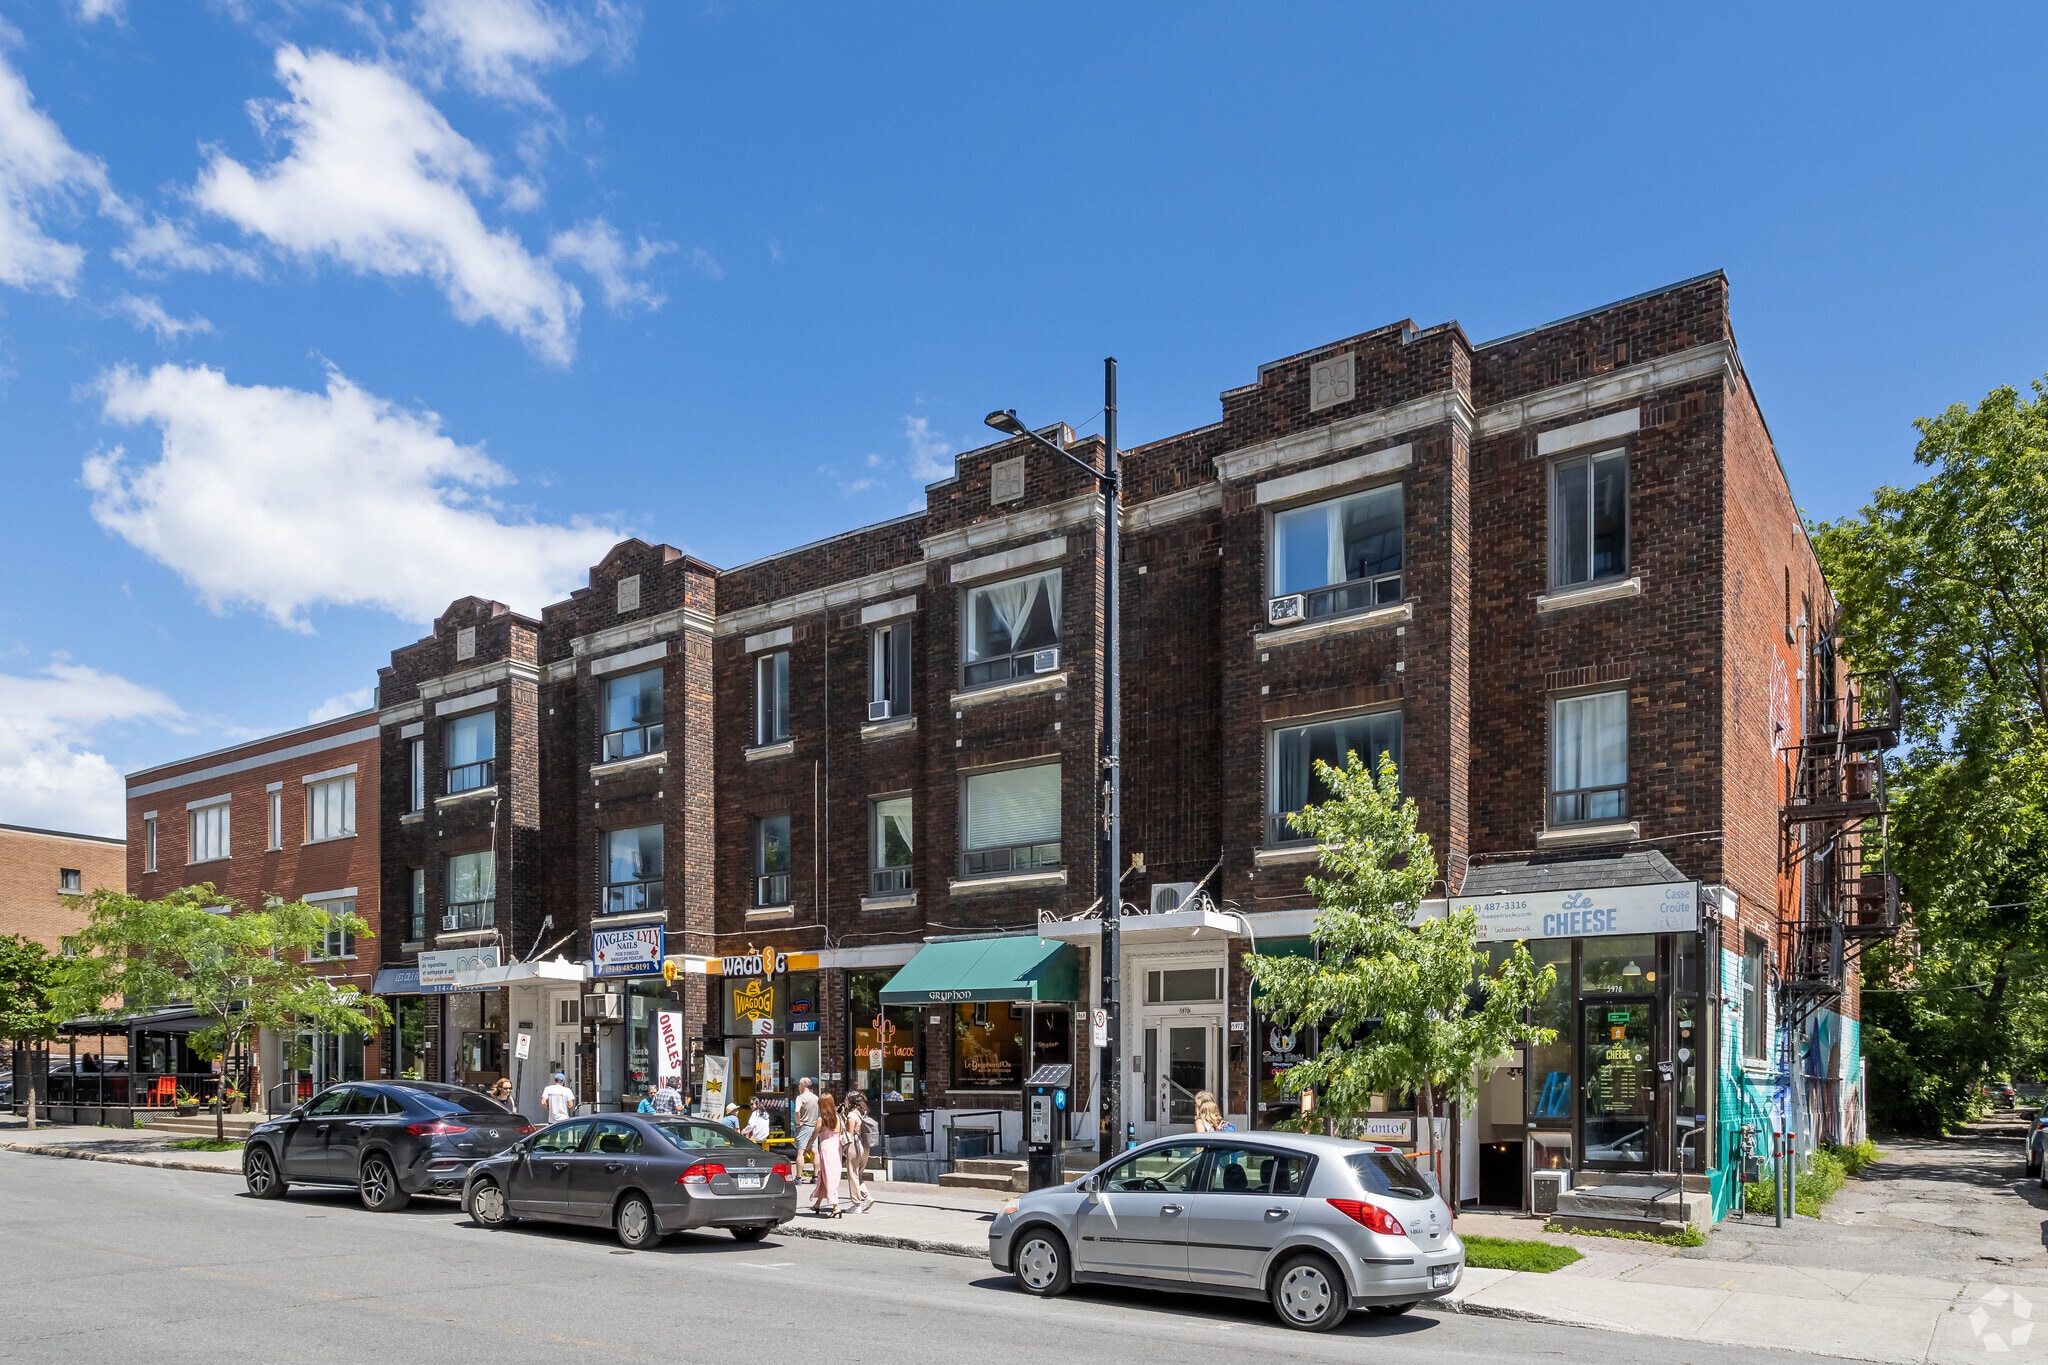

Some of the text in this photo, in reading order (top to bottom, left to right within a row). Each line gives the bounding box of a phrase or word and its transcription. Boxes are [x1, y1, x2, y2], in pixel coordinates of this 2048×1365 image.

[1665, 889, 1690, 899] Casse
[1562, 891, 1593, 910] Le
[1484, 901, 1527, 911] 487-3316
[1660, 902, 1690, 913] Croûte
[1543, 908, 1617, 936] CHEESE
[596, 930, 660, 952] ONGLES LYLY
[617, 942, 638, 950] NAILS
[606, 963, 650, 973] (514) 485-0191
[737, 993, 770, 1014] WAGDOG
[660, 1014, 681, 1069] ONGLES
[1612, 1041, 1623, 1049] Le
[1606, 1049, 1630, 1059] CHEESE
